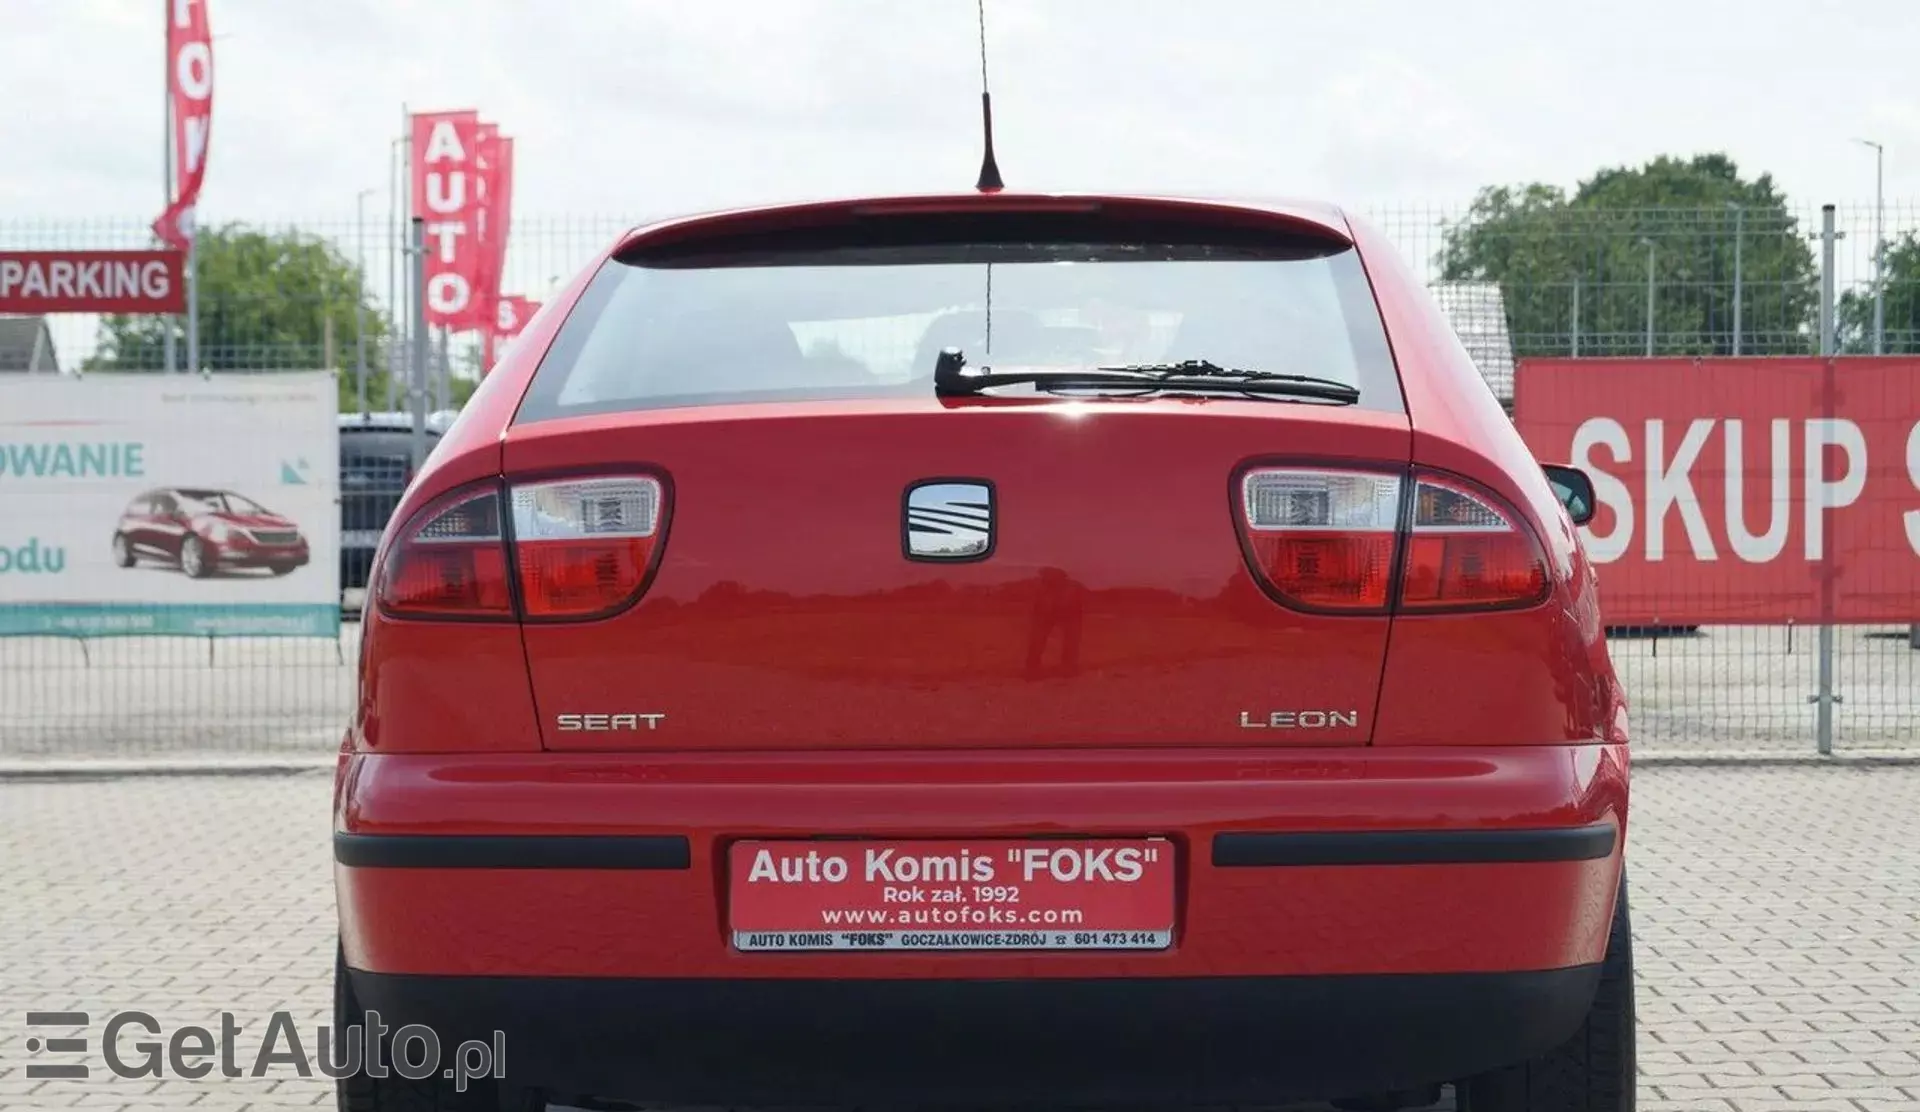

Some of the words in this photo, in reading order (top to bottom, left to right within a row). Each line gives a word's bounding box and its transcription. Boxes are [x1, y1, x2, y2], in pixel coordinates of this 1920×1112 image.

[424, 120, 470, 314] AUTO
[0, 260, 170, 298] PARKING
[0, 442, 145, 478] WANIE
[1570, 417, 1868, 563] SKUP
[557, 713, 665, 731] SEAT
[1240, 710, 1357, 728] LEON
[748, 849, 849, 882] Auto
[865, 848, 995, 882] Komis
[1008, 848, 1158, 882] "FOKS"
[884, 886, 925, 903] Rok
[931, 886, 967, 903] zał.
[973, 886, 1020, 903] 1992
[822, 906, 1083, 924] www.autofoks.com
[750, 934, 785, 947] AUTO
[789, 934, 833, 947] KOMIS
[901, 931, 1047, 946] GOCZAŁKOWICE-ZDRÓJ
[1075, 933, 1097, 945] 601
[1103, 933, 1129, 945] 473
[1130, 933, 1156, 945] 414
